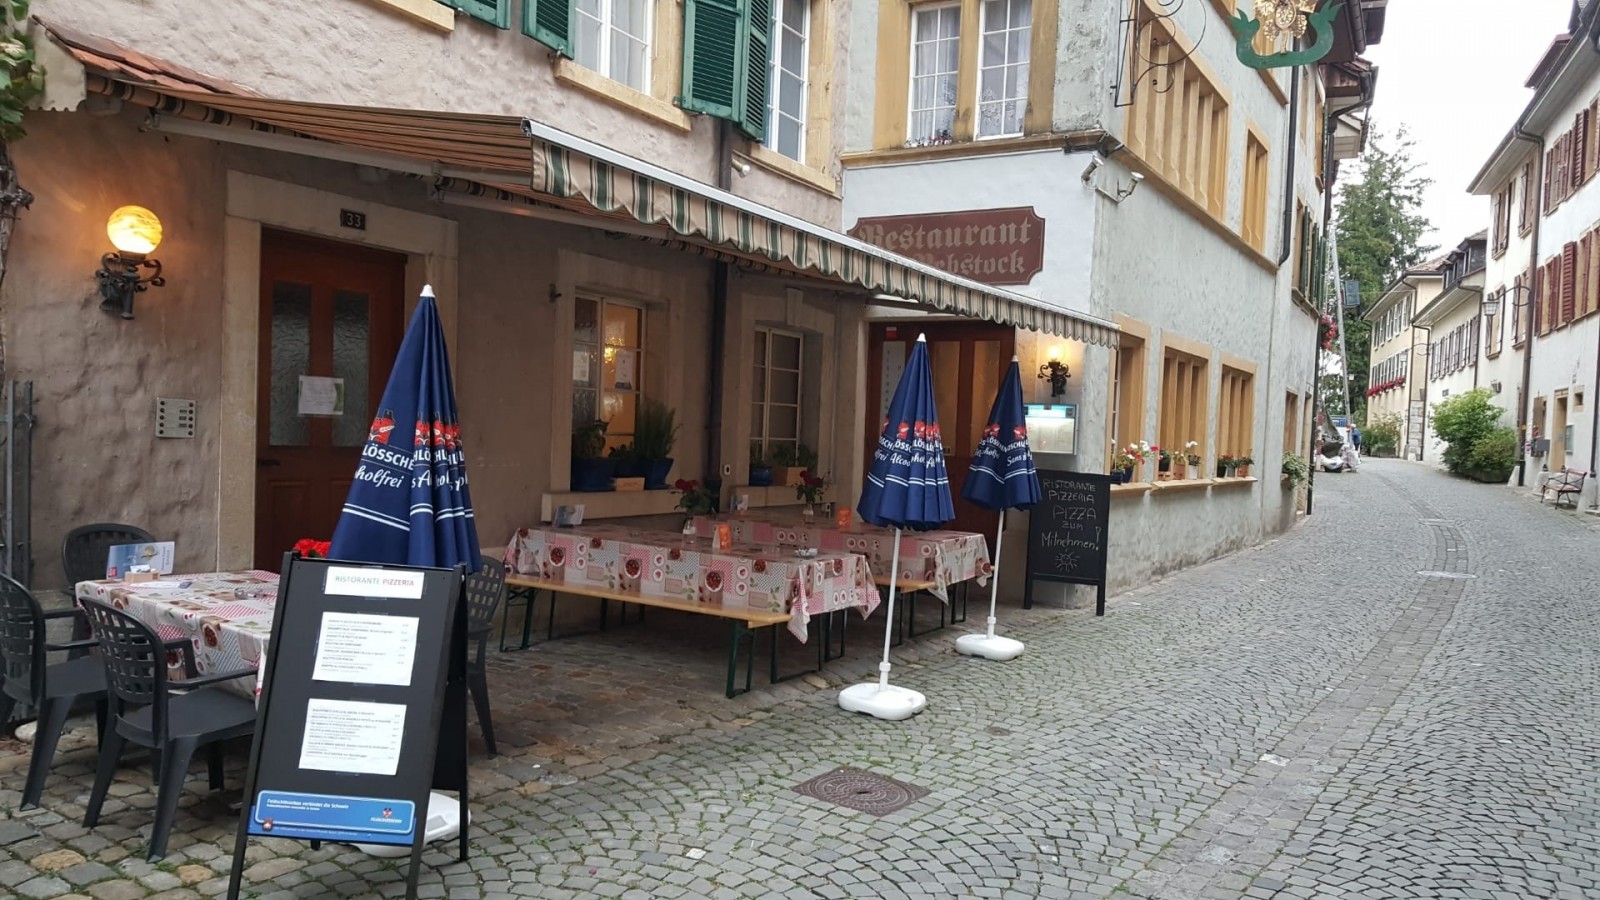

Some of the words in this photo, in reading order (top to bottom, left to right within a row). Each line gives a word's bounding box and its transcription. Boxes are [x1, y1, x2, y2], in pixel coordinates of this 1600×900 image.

[346, 212, 361, 228] 33
[859, 217, 1032, 250] Restaurant
[362, 443, 414, 471] LÖSSCHE
[355, 464, 405, 489] holfrei
[1042, 479, 1096, 492] RISTORANTE
[1048, 490, 1095, 504] PIZZERIA
[1052, 505, 1097, 520] PIZZA
[335, 575, 380, 585] RISTORANTE
[382, 578, 415, 587] PIZZERIA
